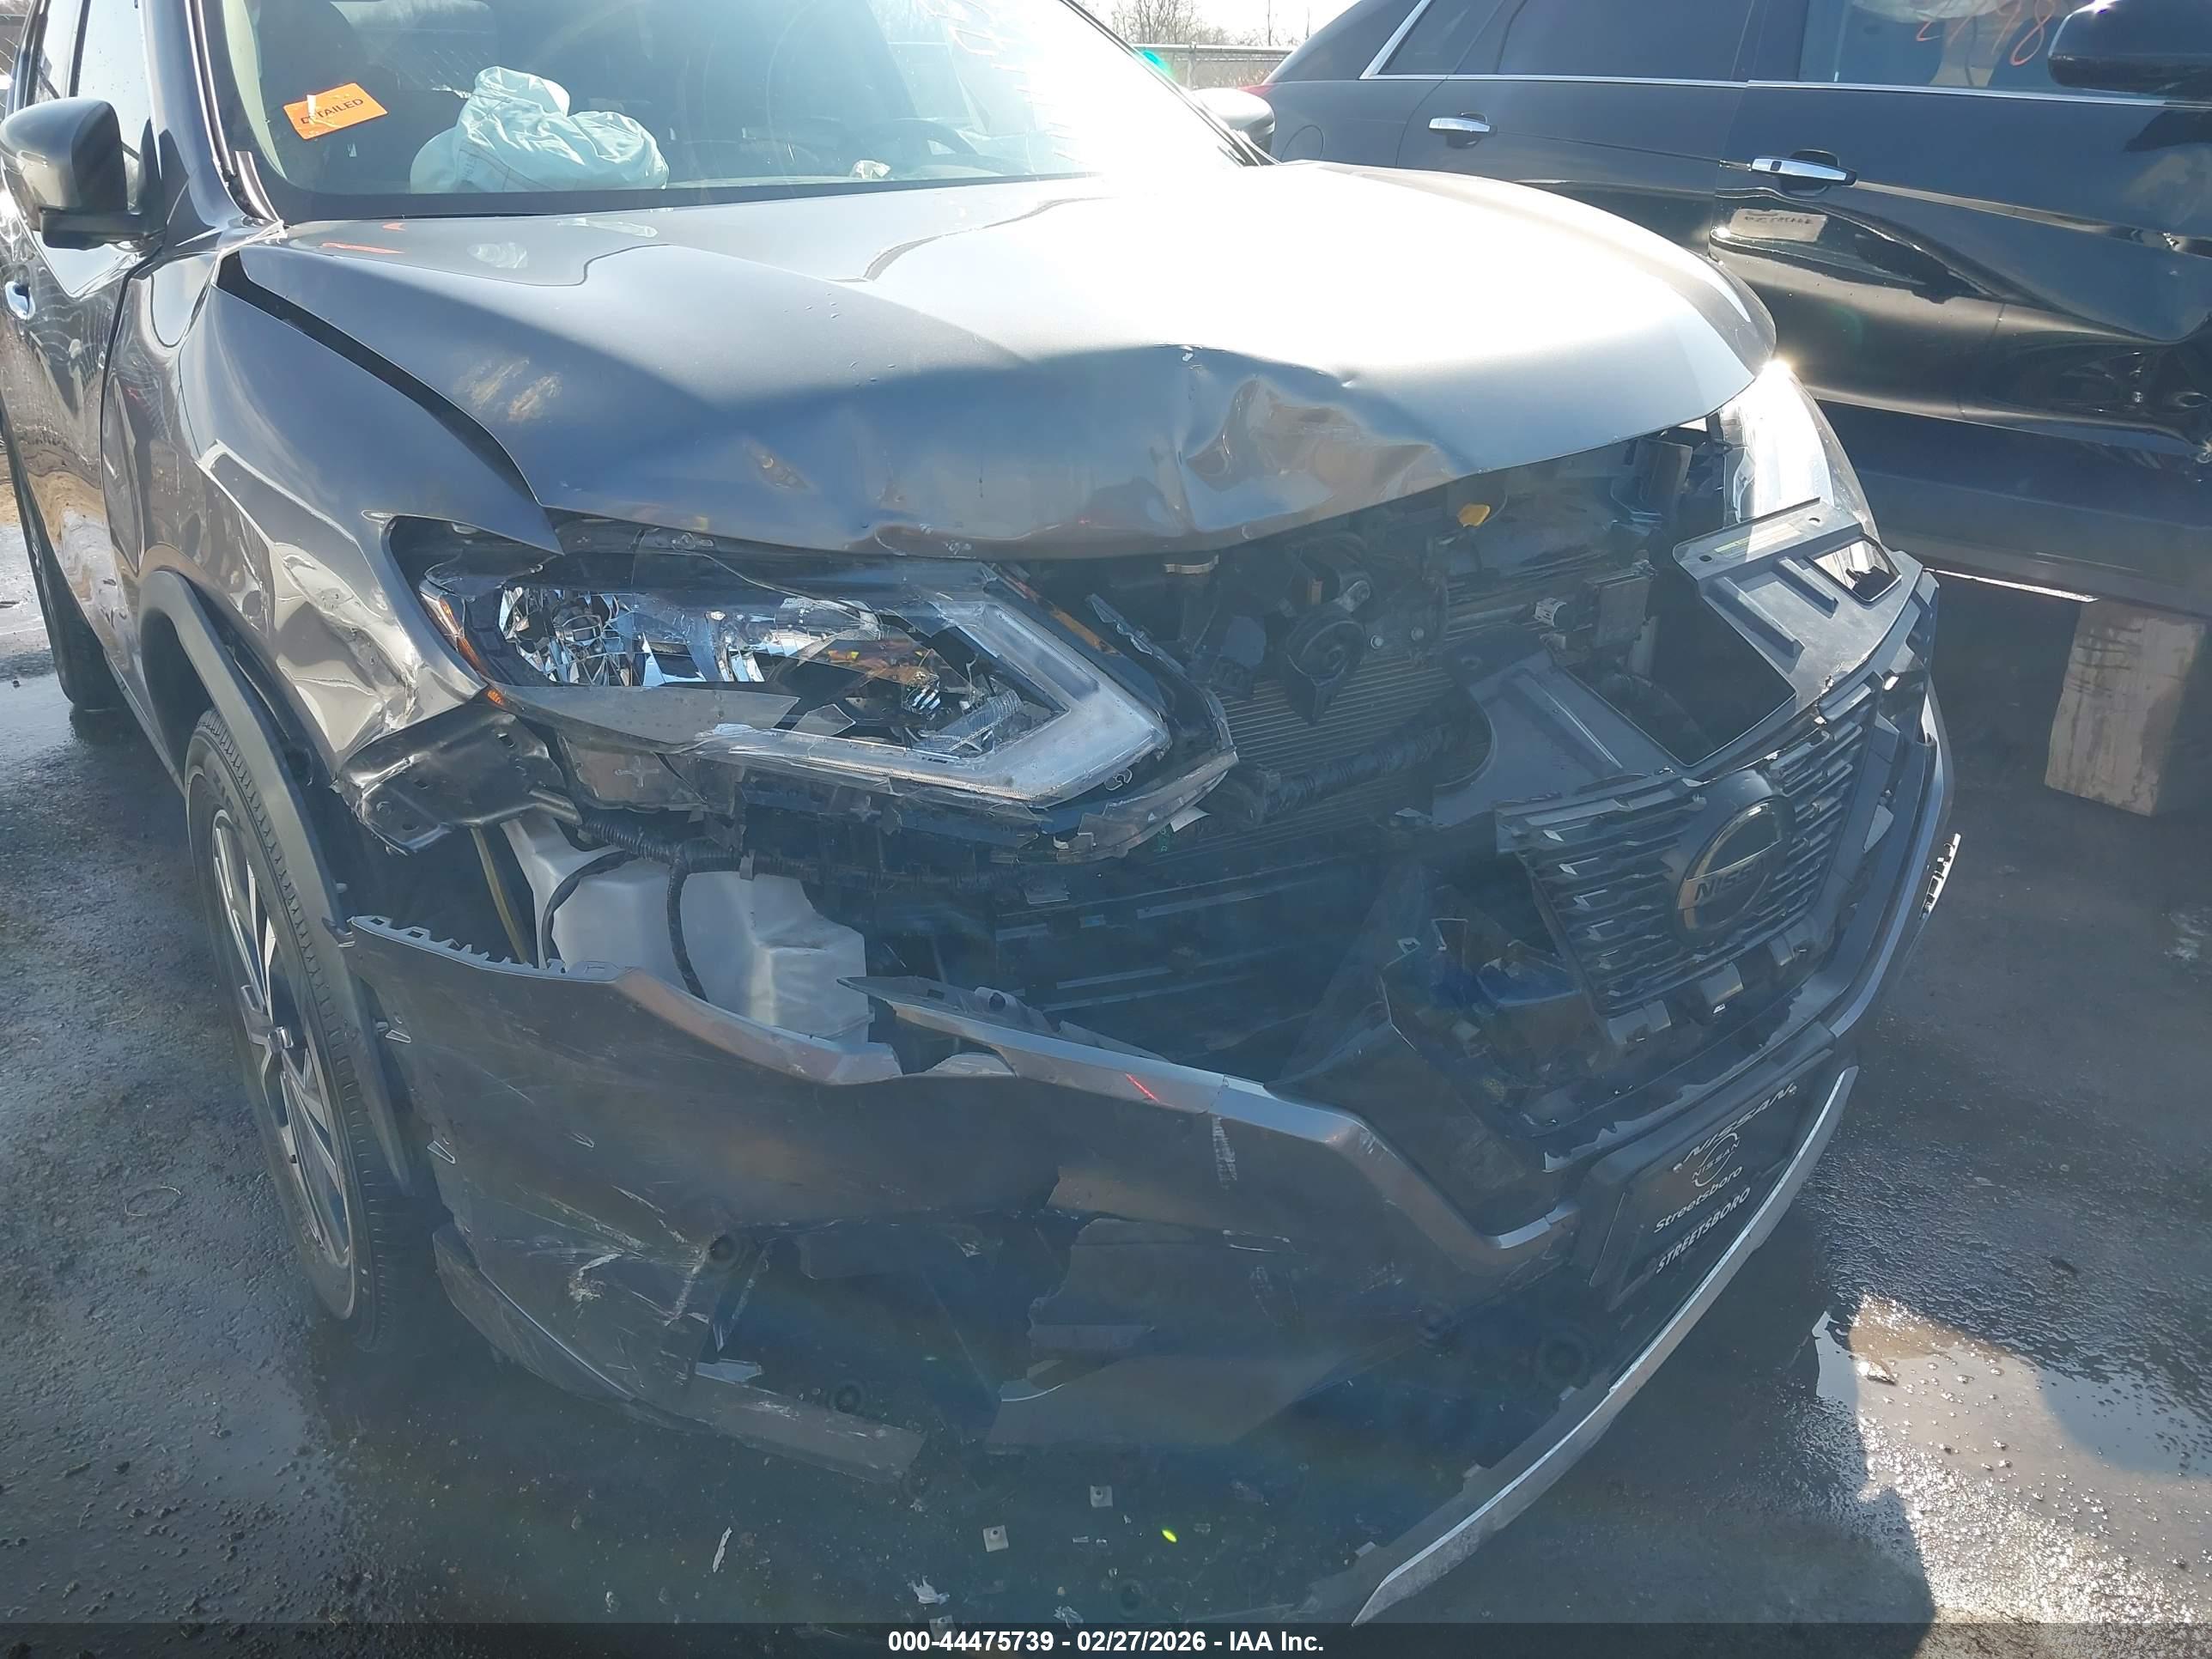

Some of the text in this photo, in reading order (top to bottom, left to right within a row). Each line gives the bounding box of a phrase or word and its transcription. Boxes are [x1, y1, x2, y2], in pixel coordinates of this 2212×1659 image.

[301, 98, 364, 124] DTAILED
[1682, 1082, 1795, 1164] NISSAN
[1692, 1139, 1741, 1180] NISSAN
[1654, 1166, 1743, 1233] Streetsboro
[1656, 1187, 1751, 1273] STREETSBORO
